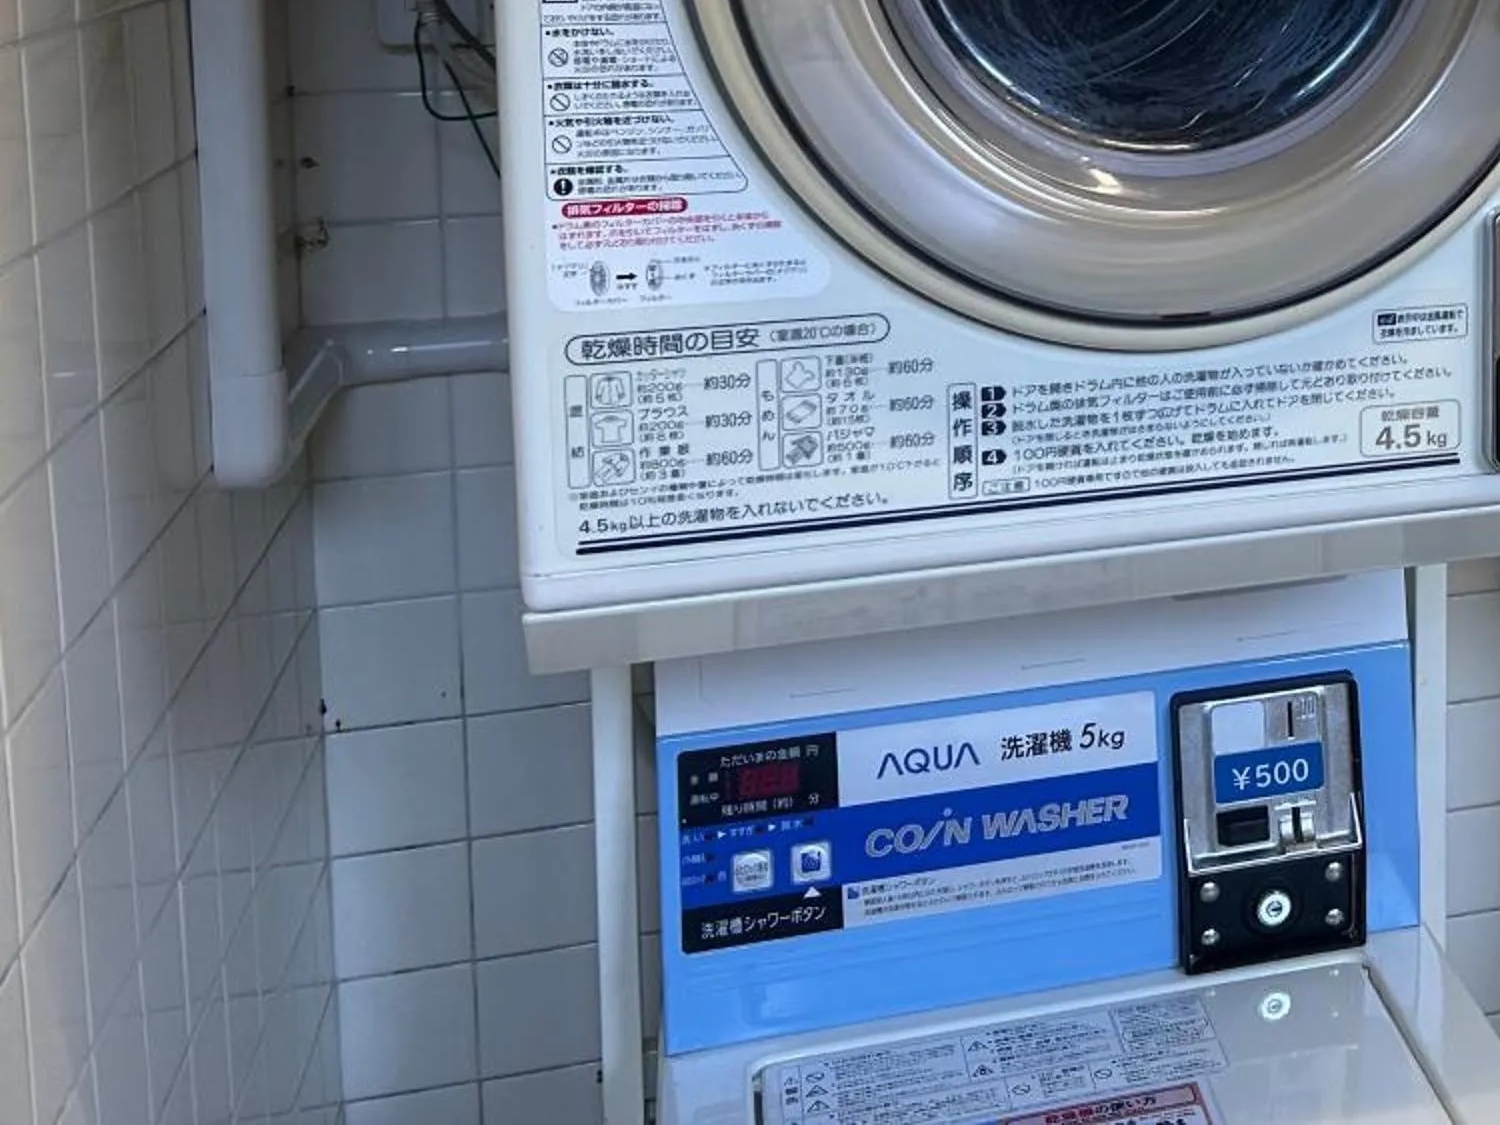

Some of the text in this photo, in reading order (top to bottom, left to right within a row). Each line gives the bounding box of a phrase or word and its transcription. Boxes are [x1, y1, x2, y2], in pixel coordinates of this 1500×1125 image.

[580, 330, 760, 359] 乾燥時間の目安
[704, 373, 751, 391] 約30分
[889, 357, 934, 375] 約60分
[638, 405, 689, 420] ブラウス
[705, 411, 752, 429] 約30分
[952, 390, 973, 492] 操作順序
[1375, 424, 1448, 450] 4.5 kg
[578, 489, 890, 535] 4.5kg以上の洗濯物を入れないでください。
[1000, 721, 1125, 762] 洗濯機 5kg
[877, 741, 981, 780] AQUA
[1232, 758, 1310, 791] ¥500
[981, 793, 1130, 841] WASHER
[701, 906, 827, 940] 洗濯槽シャワーボタン
